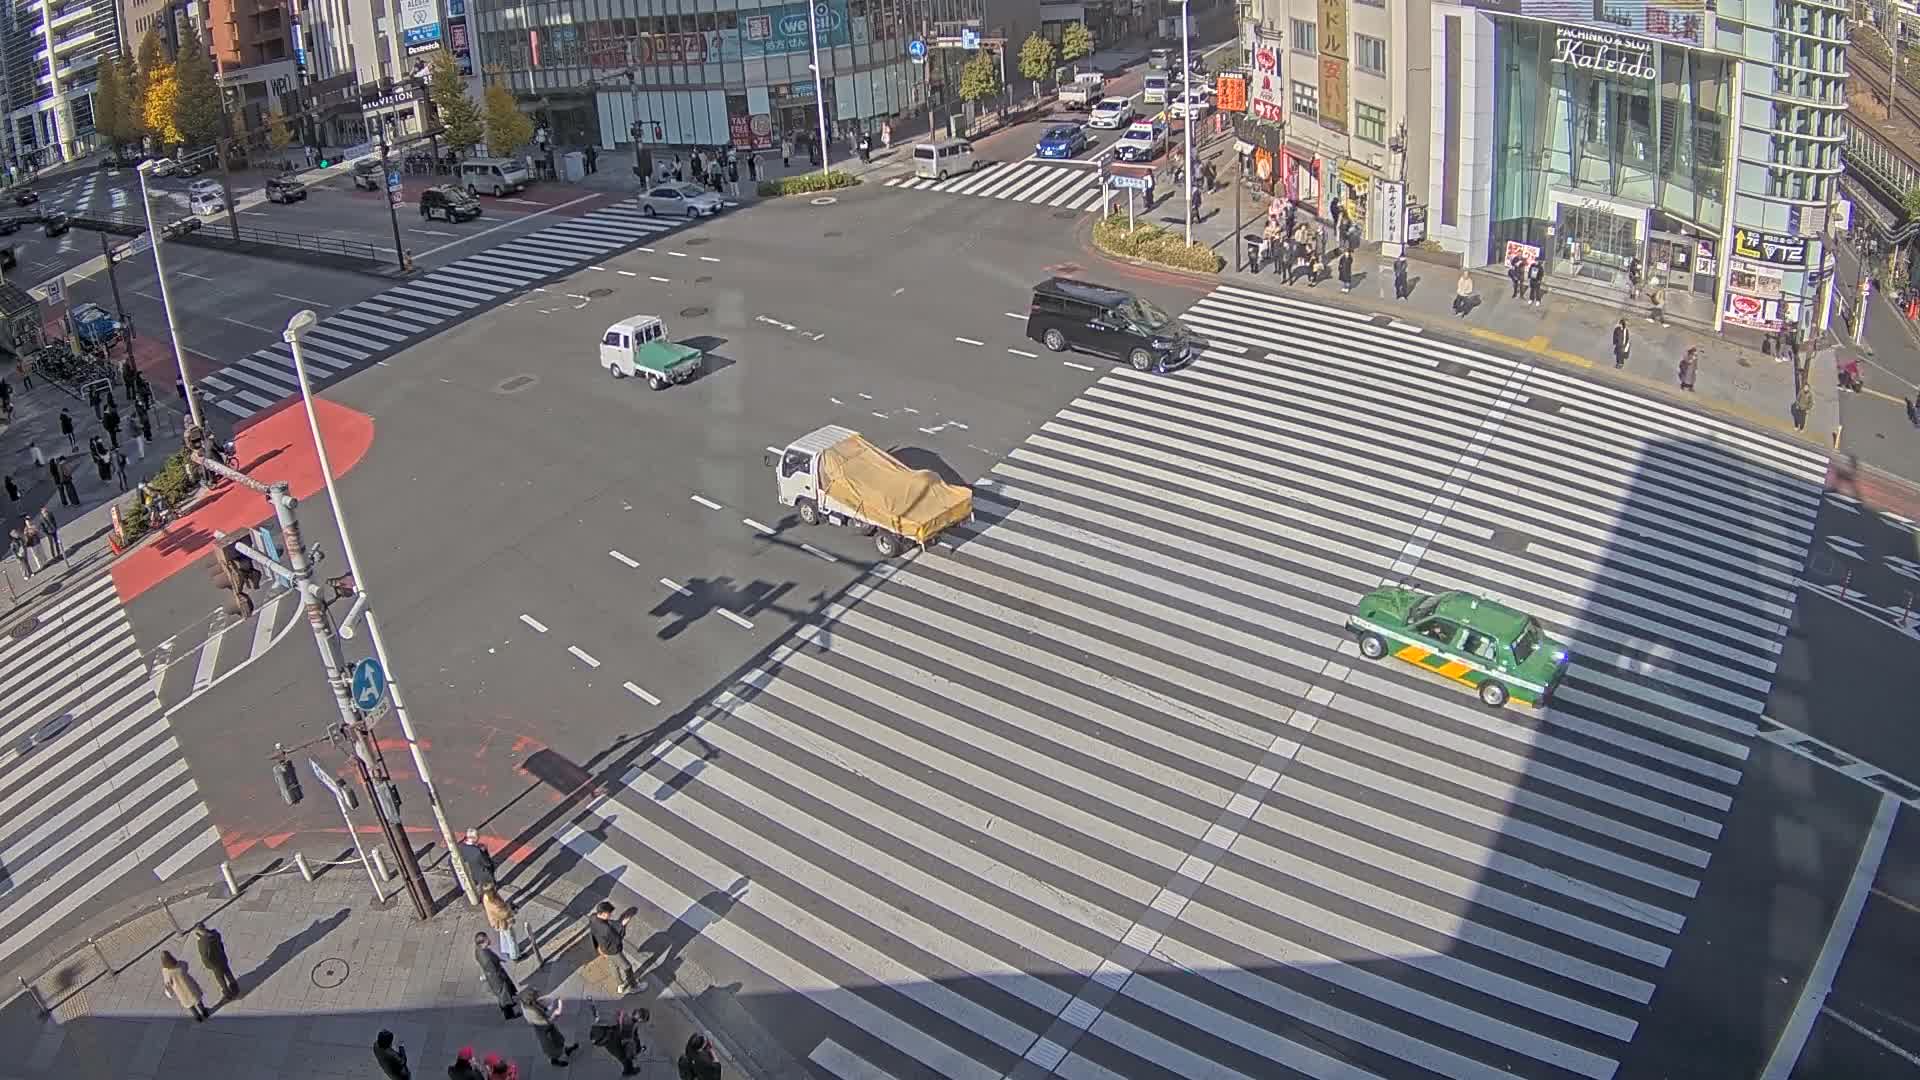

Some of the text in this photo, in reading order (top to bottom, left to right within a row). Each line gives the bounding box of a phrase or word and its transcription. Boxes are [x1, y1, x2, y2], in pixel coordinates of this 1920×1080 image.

[1556, 27, 1613, 44] PACHINKO
[1551, 38, 1657, 80] Kaleido
[731, 117, 747, 125] TAX
[1747, 237, 1760, 247] 7F
